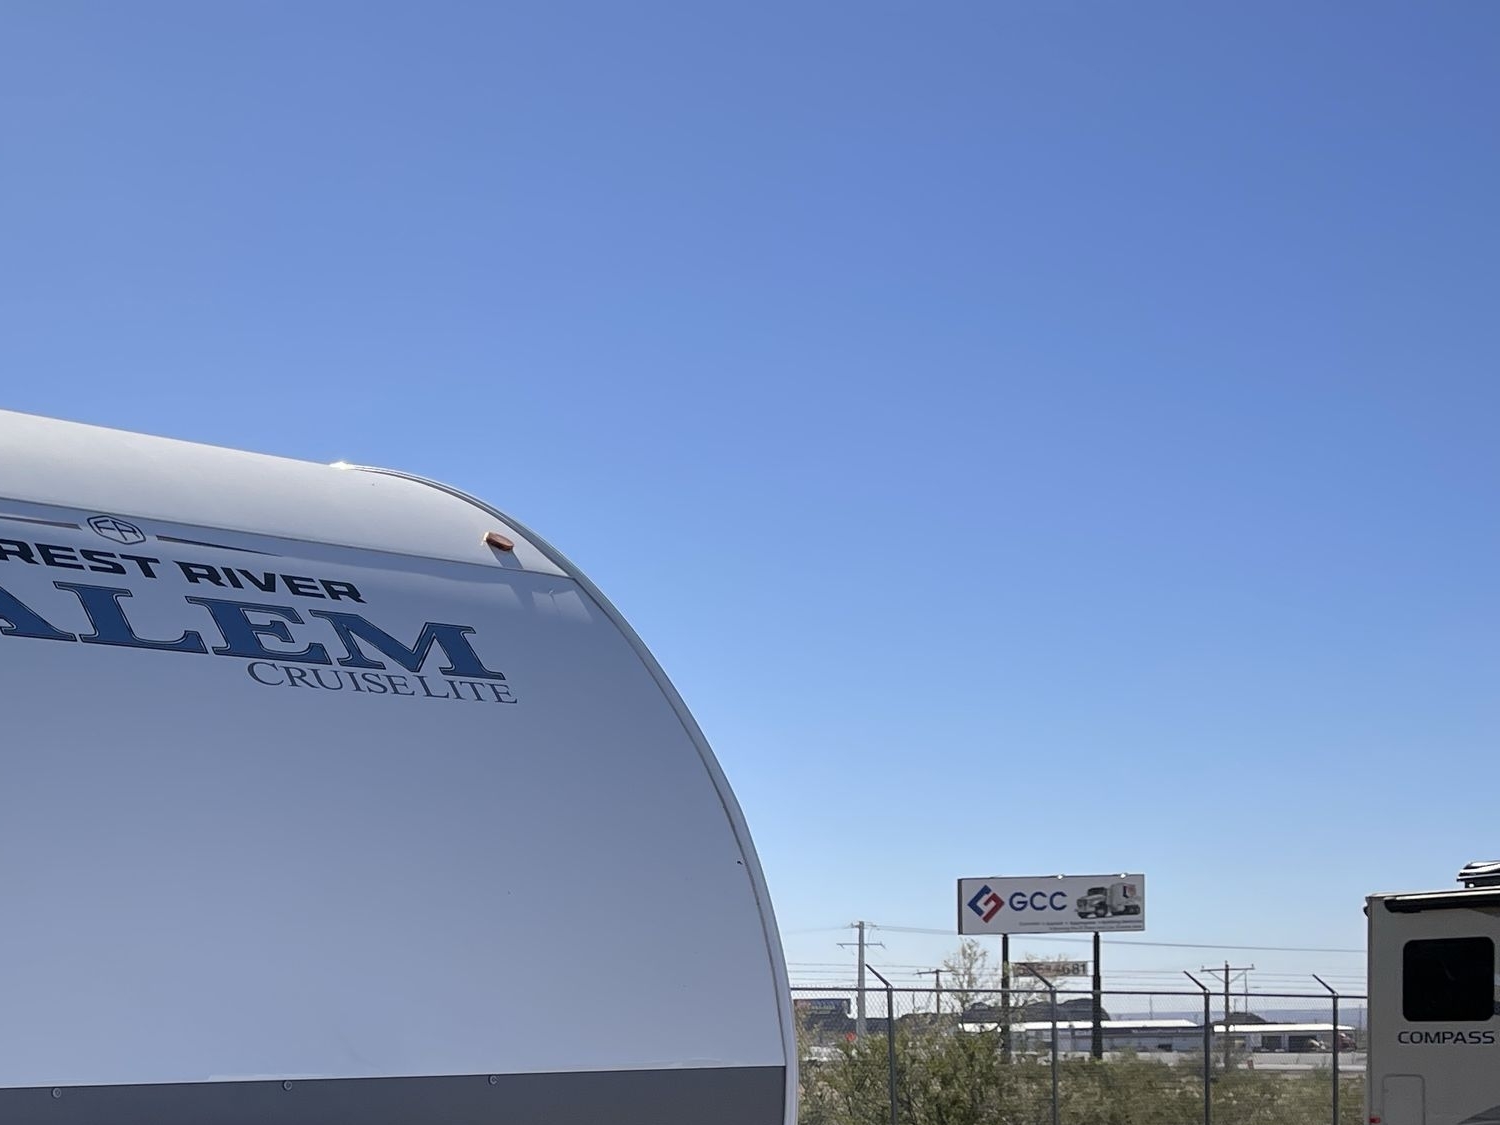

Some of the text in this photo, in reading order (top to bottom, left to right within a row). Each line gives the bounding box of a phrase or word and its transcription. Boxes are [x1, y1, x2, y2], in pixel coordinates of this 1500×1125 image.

[172, 560, 367, 604] RIVER
[1008, 891, 1068, 912] GCC
[1397, 1031, 1496, 1045] COMPASS
